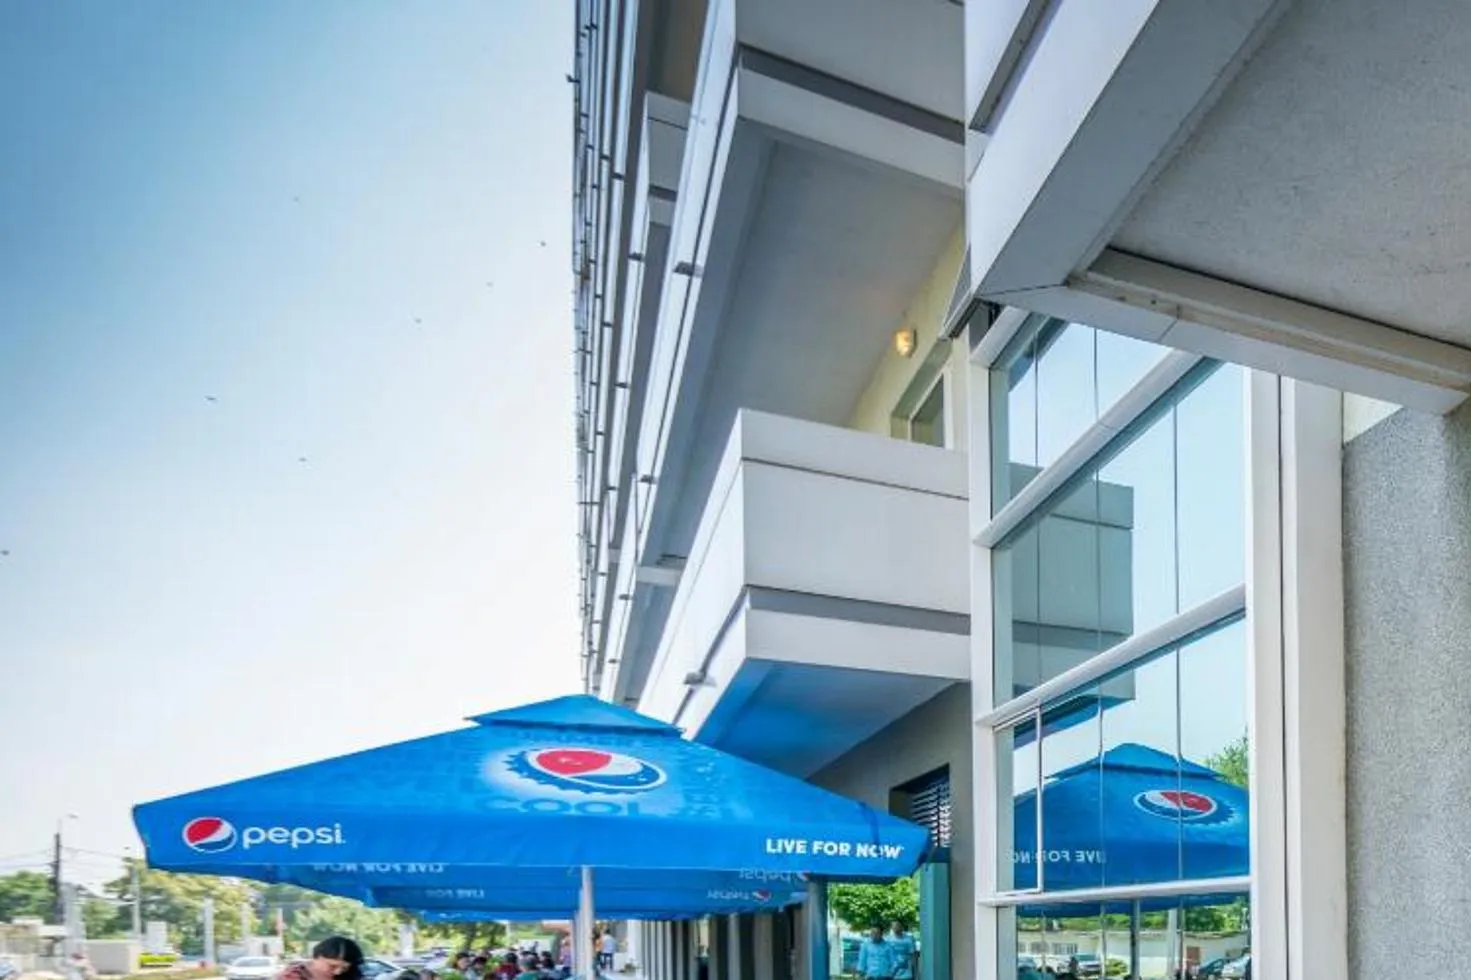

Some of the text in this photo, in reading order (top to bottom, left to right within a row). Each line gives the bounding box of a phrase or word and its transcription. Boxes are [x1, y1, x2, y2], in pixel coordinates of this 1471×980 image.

[243, 823, 344, 849] pepsi
[766, 838, 901, 859] LIVE FOR NOW
